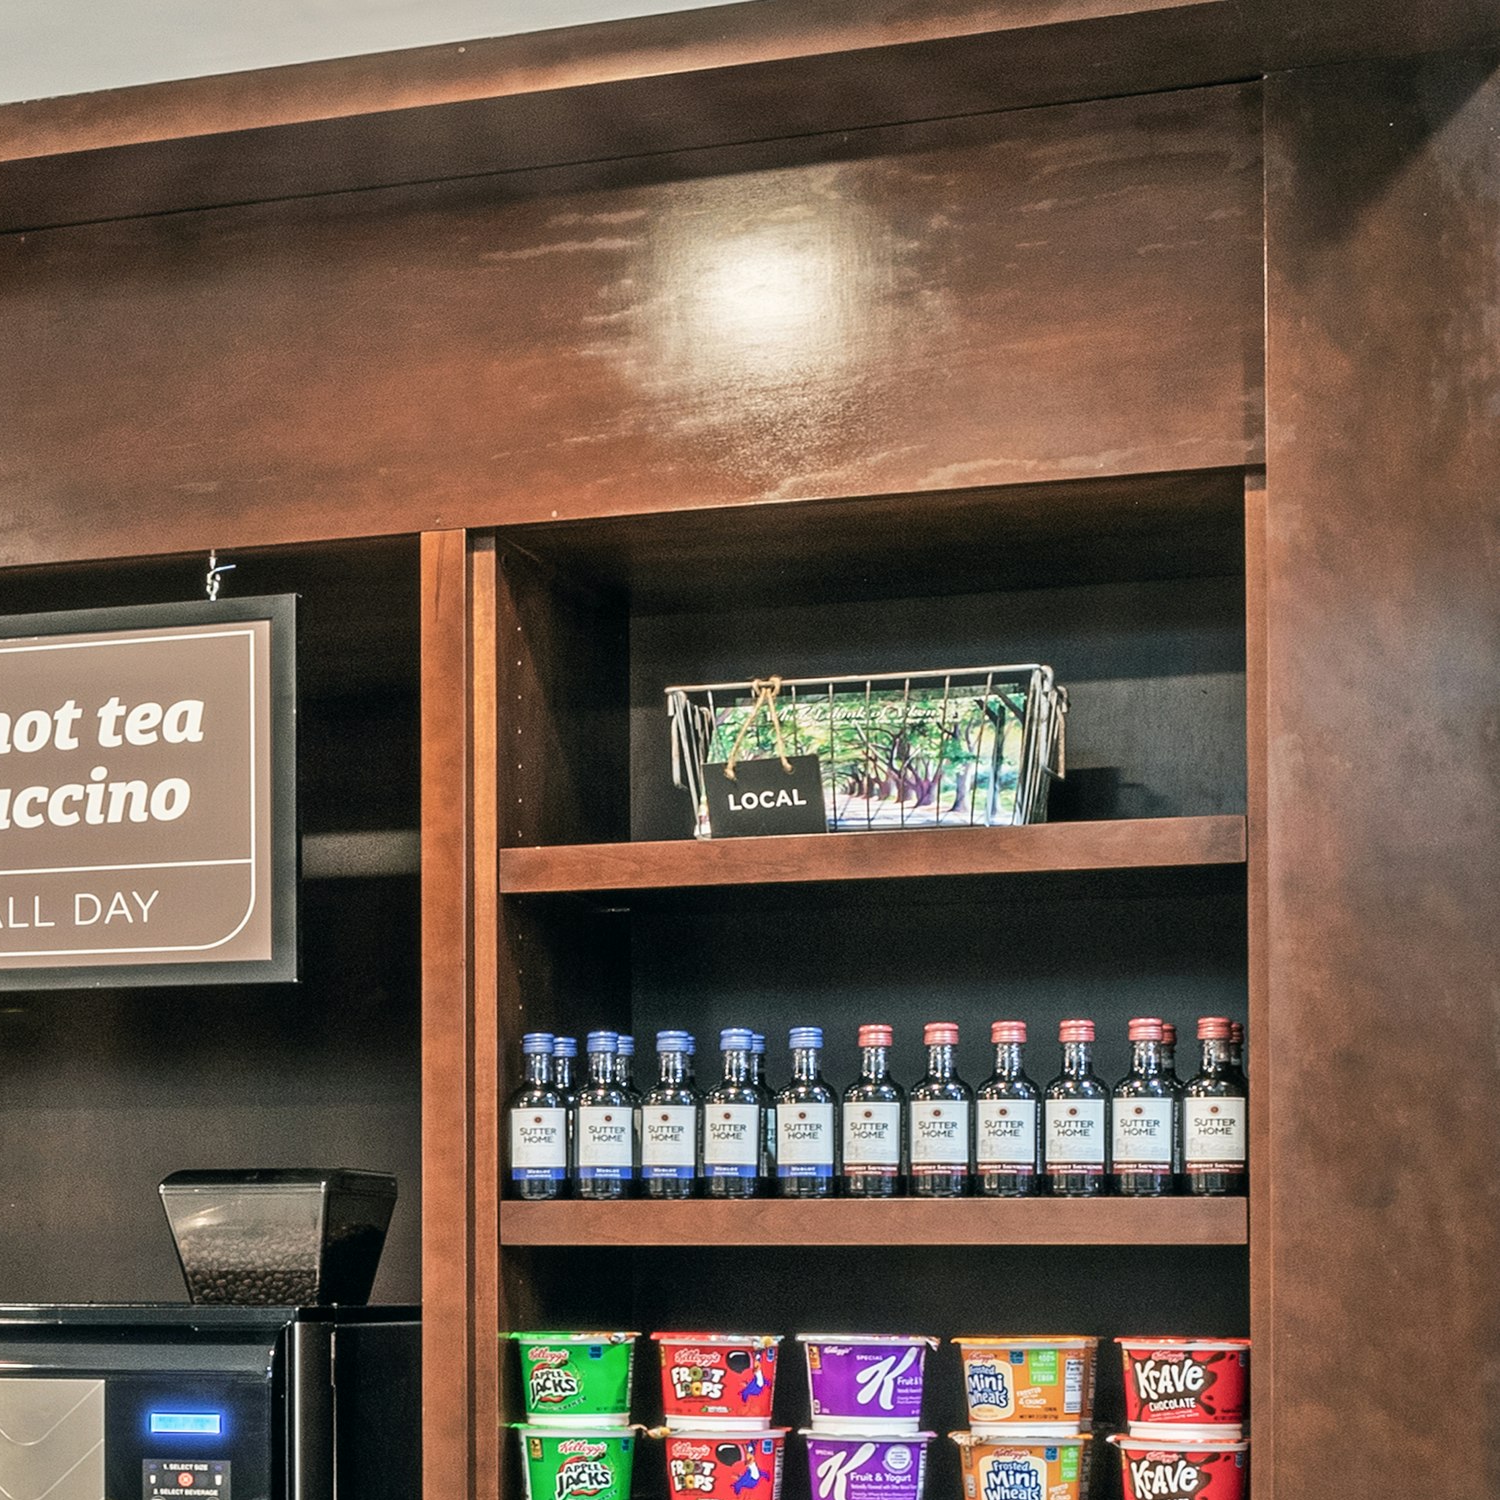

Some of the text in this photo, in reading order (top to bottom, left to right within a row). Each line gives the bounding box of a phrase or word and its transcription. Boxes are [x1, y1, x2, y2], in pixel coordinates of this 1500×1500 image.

[97, 695, 204, 746] tea
[727, 788, 807, 811] LOCAL
[73, 889, 161, 926] DAY
[850, 1122, 888, 1131] SUTTER
[918, 1121, 957, 1130] SUTTER
[984, 1120, 1023, 1128] SUTTER
[1053, 1120, 1094, 1128] SUTTER
[1120, 1119, 1160, 1127] SUTTER
[1194, 1118, 1236, 1127] SUTTER
[520, 1128, 556, 1136] SUTTER
[588, 1126, 626, 1134] SUTTER
[648, 1126, 684, 1134] SUTTER
[710, 1123, 747, 1132] SUTTER
[784, 1123, 822, 1132] SUTTER
[1124, 1128, 1156, 1136] HOME
[1198, 1127, 1232, 1135] HOME
[713, 1132, 743, 1140] HOME
[788, 1132, 819, 1140] HOME
[853, 1131, 885, 1139] HOME
[922, 1130, 954, 1138] HOME
[988, 1128, 1021, 1137] HOME
[1057, 1128, 1090, 1137] HOME
[593, 1134, 623, 1142] HOME
[651, 1134, 680, 1142] HOME
[529, 1347, 568, 1362] Kellogg's
[675, 1349, 720, 1365] Kellogg's
[534, 1369, 563, 1380] APPLE
[671, 1366, 725, 1384] FROOT
[856, 1346, 919, 1410] K
[969, 1375, 1004, 1392] Mini
[531, 1377, 577, 1402] JACKS
[675, 1381, 724, 1399] LOOPS
[1149, 1398, 1197, 1411] CHOCOLATE
[559, 1439, 607, 1455] Kellogg's
[672, 1441, 711, 1459] Kellogg's
[565, 1463, 600, 1473] APPLE
[670, 1459, 716, 1477] FROOT
[994, 1461, 1029, 1471] Frosted
[850, 1473, 911, 1483] Fruit Yogurt
[989, 1471, 1038, 1489] Mini
[557, 1471, 611, 1499] JACKS
[674, 1474, 715, 1493] LOOPS
[159, 1488, 183, 1496] SELECT
